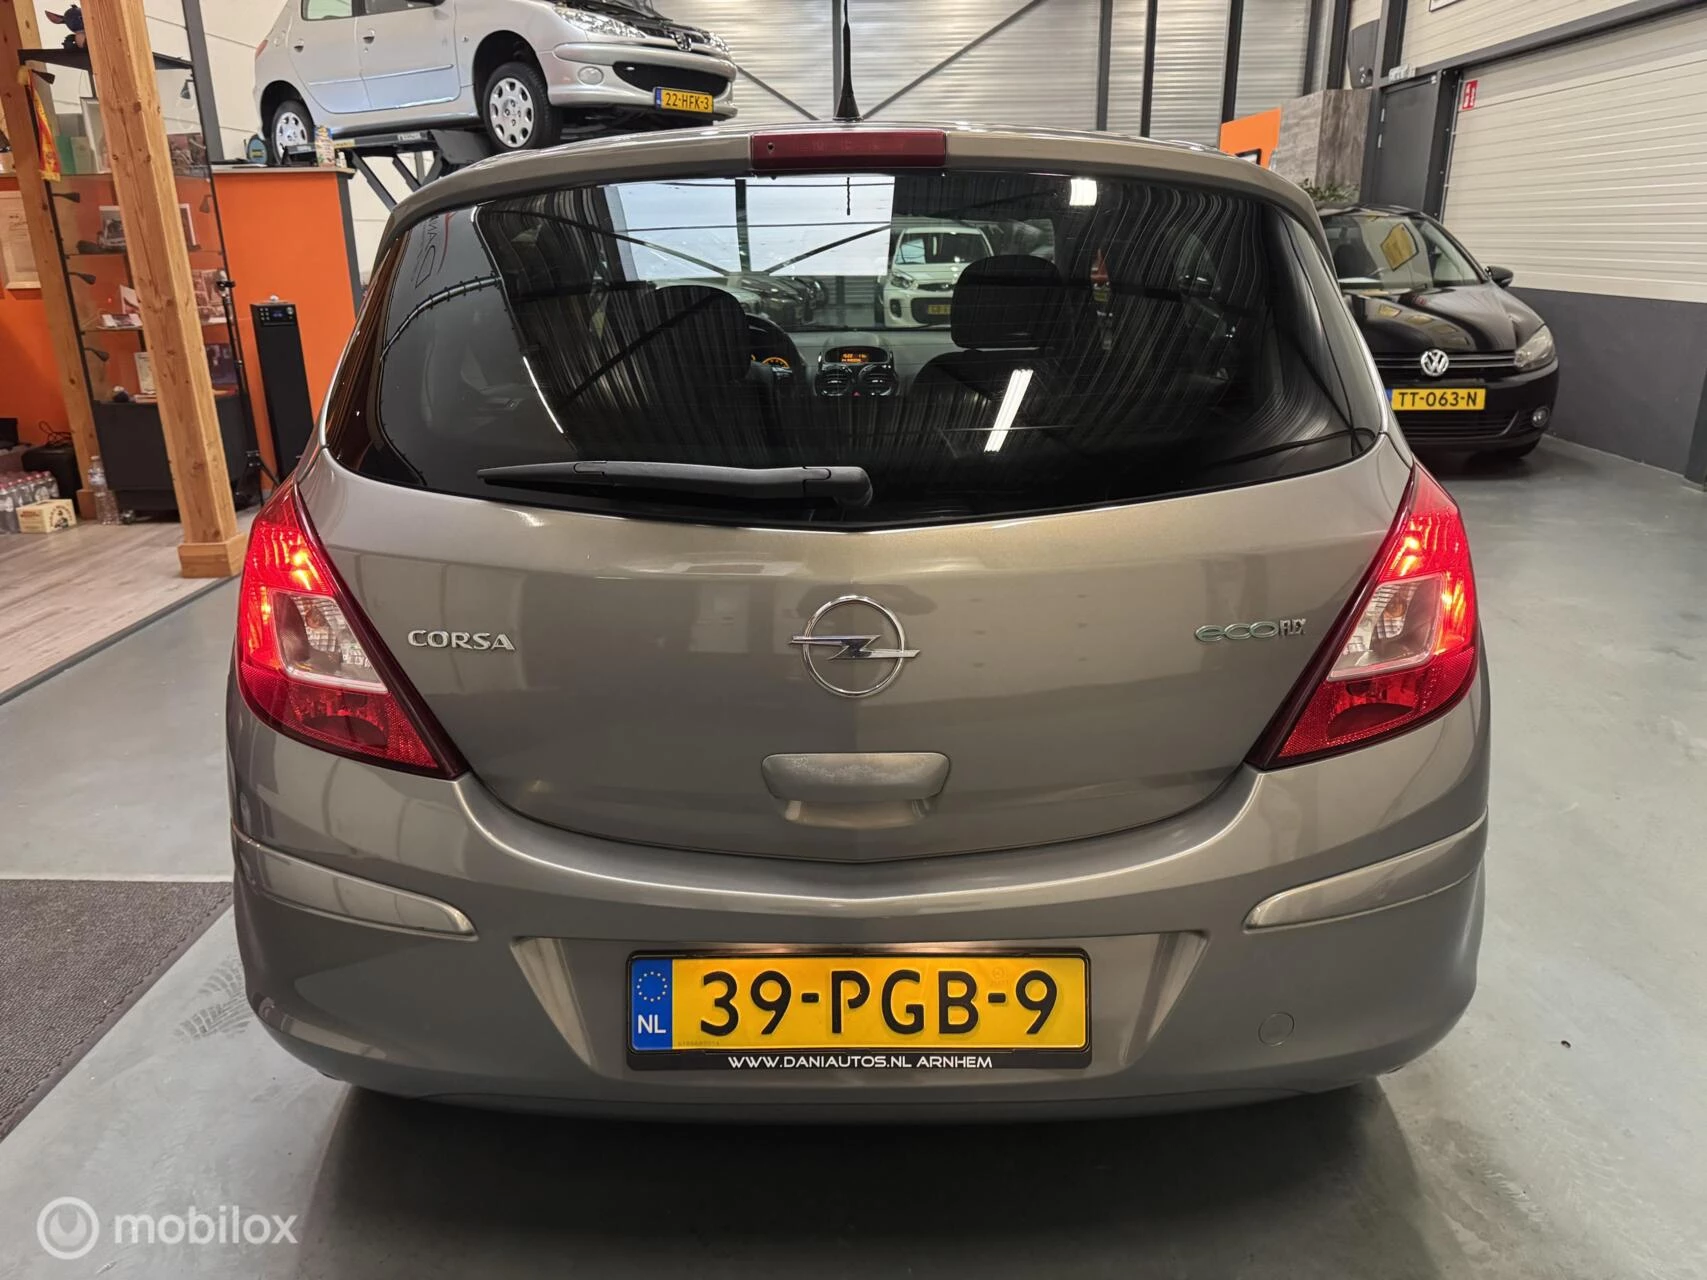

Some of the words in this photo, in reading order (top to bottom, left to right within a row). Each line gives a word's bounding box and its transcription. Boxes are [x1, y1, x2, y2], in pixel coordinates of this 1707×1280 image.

[665, 92, 709, 110] 22-HFK-3
[1398, 391, 1477, 407] TT-063-N
[407, 629, 515, 651] CORSA
[700, 969, 1058, 1037] 39-PGB-9
[637, 1014, 667, 1034] NL
[728, 1056, 912, 1069] WWW.DANIAUTOS.NL
[916, 1056, 993, 1069] ARNHEM
